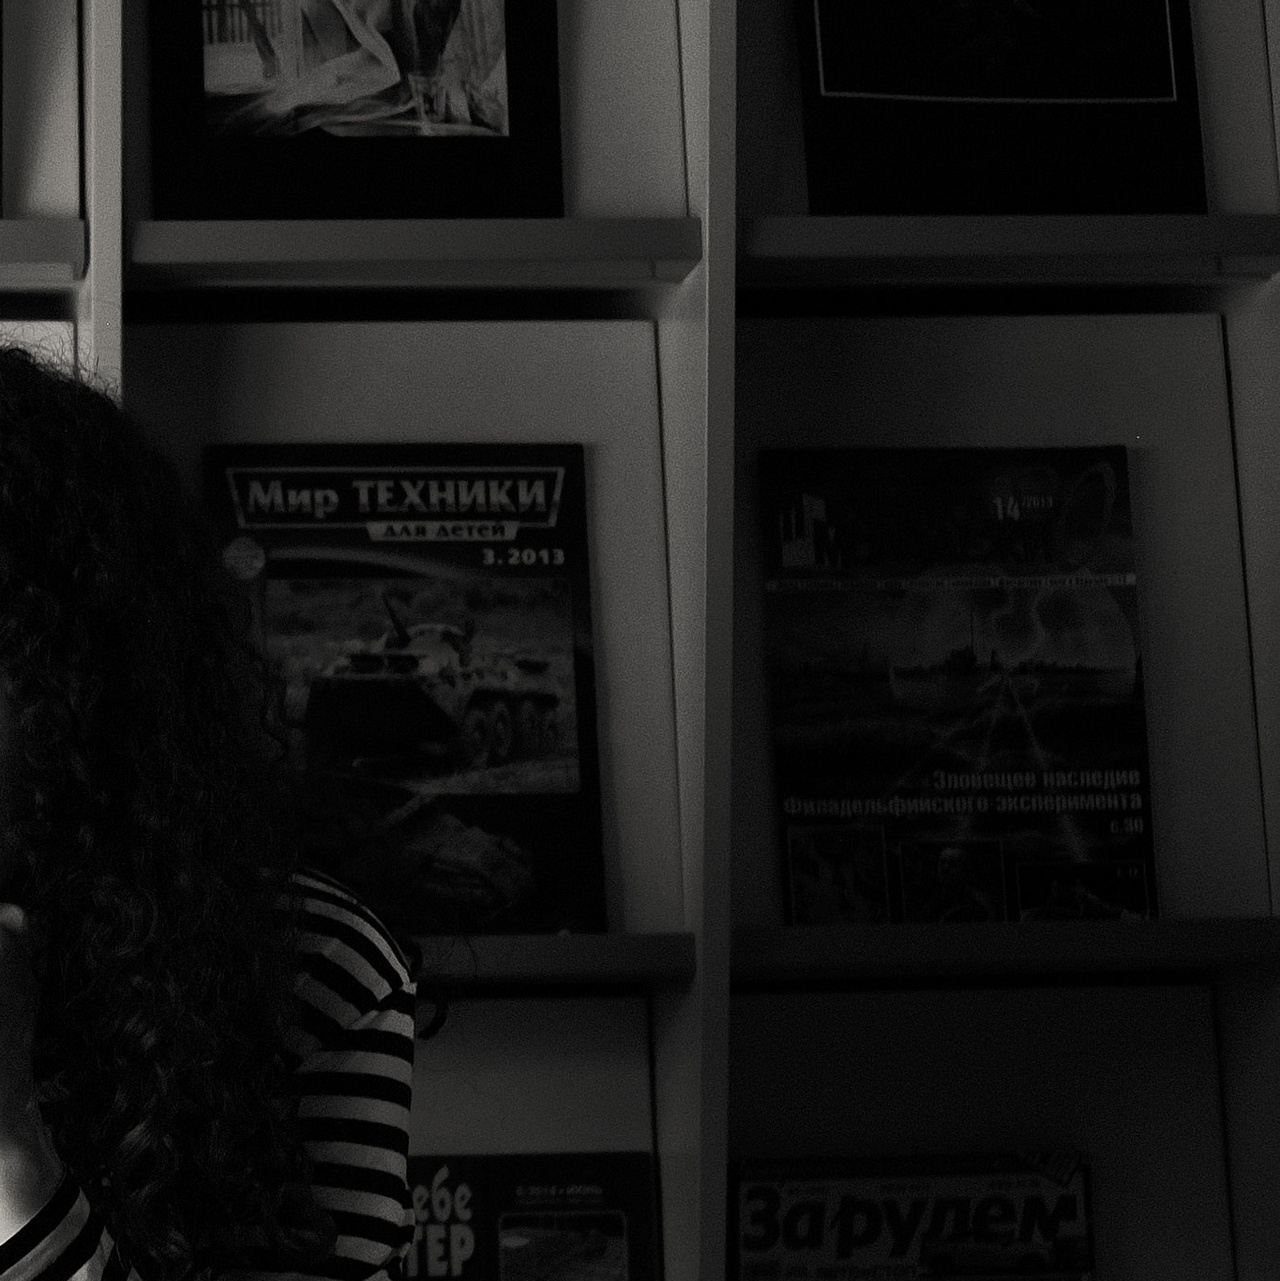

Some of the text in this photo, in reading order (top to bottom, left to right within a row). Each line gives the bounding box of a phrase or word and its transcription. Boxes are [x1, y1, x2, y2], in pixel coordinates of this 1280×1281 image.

[247, 479, 548, 520] Мир ТЕХНИКИ
[482, 548, 566, 566] 3.2013
[412, 1164, 473, 1223] ебе
[406, 1223, 476, 1278] ТЕР
